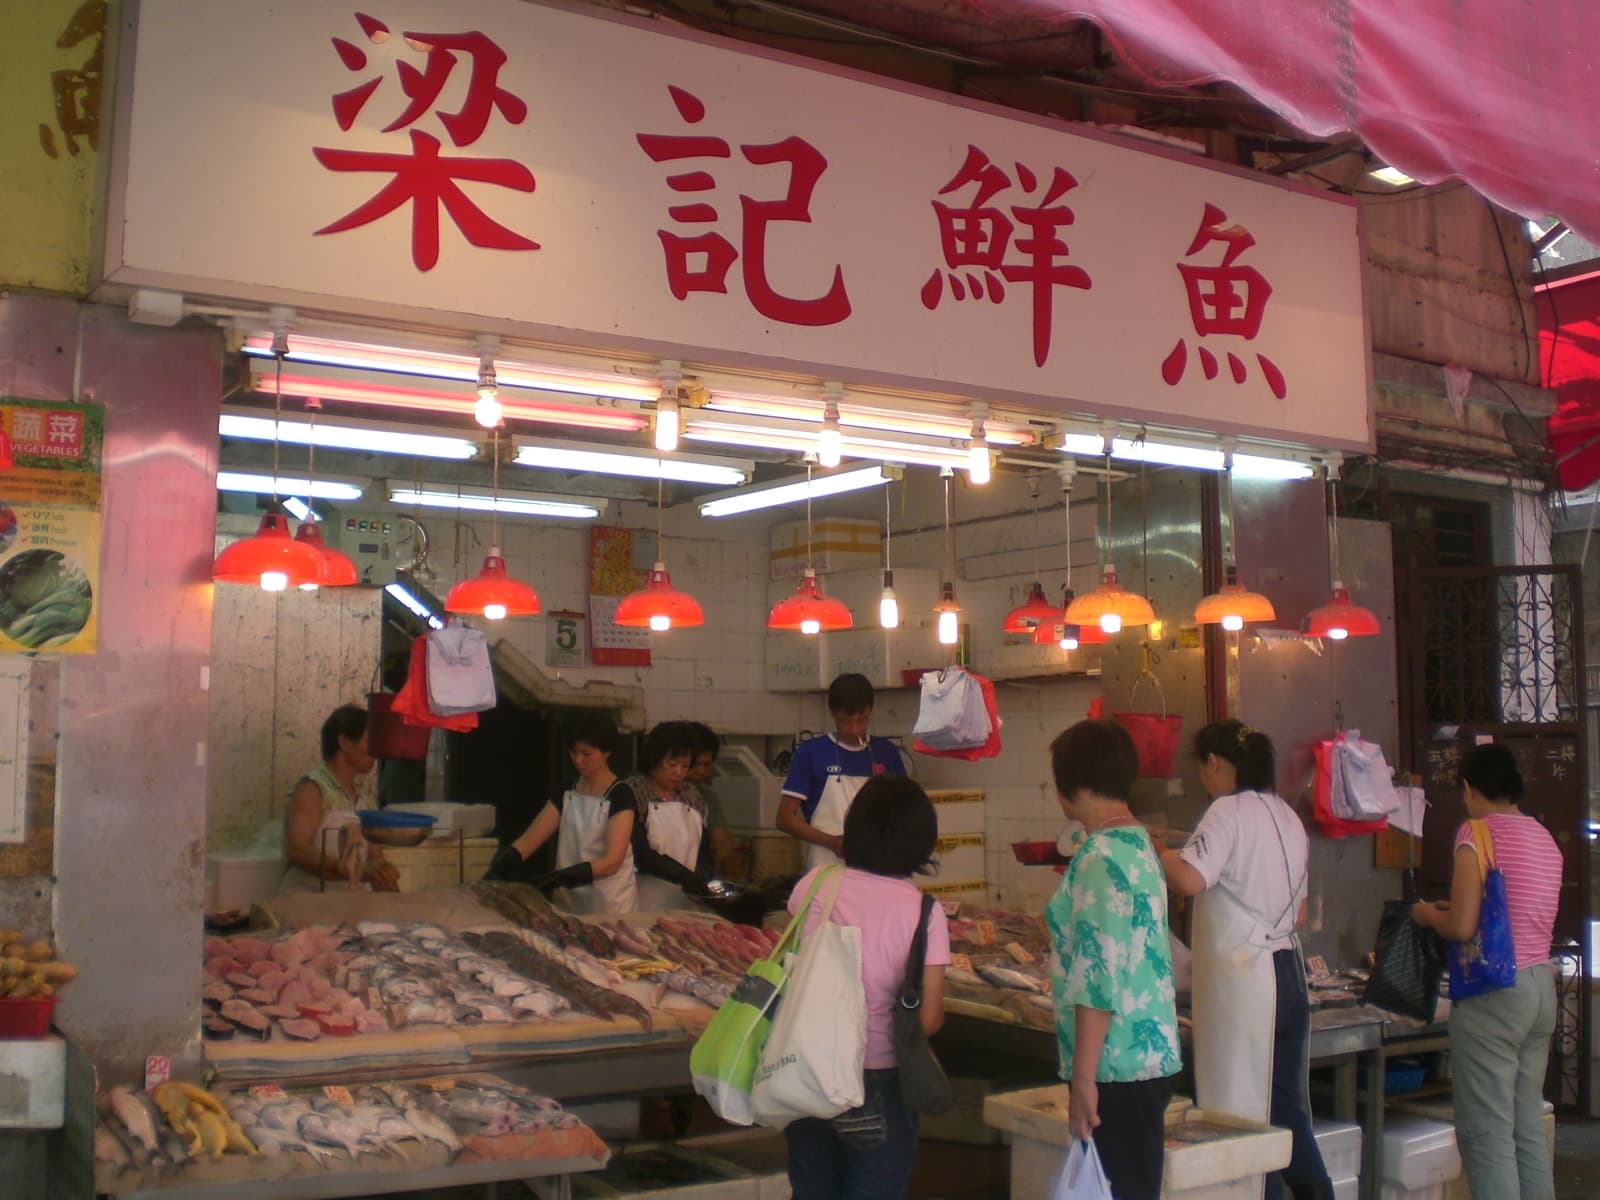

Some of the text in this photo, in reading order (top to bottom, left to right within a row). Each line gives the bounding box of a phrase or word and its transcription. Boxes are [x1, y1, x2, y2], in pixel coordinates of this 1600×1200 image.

[312, 13, 1286, 400] 梁記鮮魚
[12, 411, 77, 443] 蔬菜
[10, 443, 80, 457] VEGETABLES
[556, 620, 577, 650] 5
